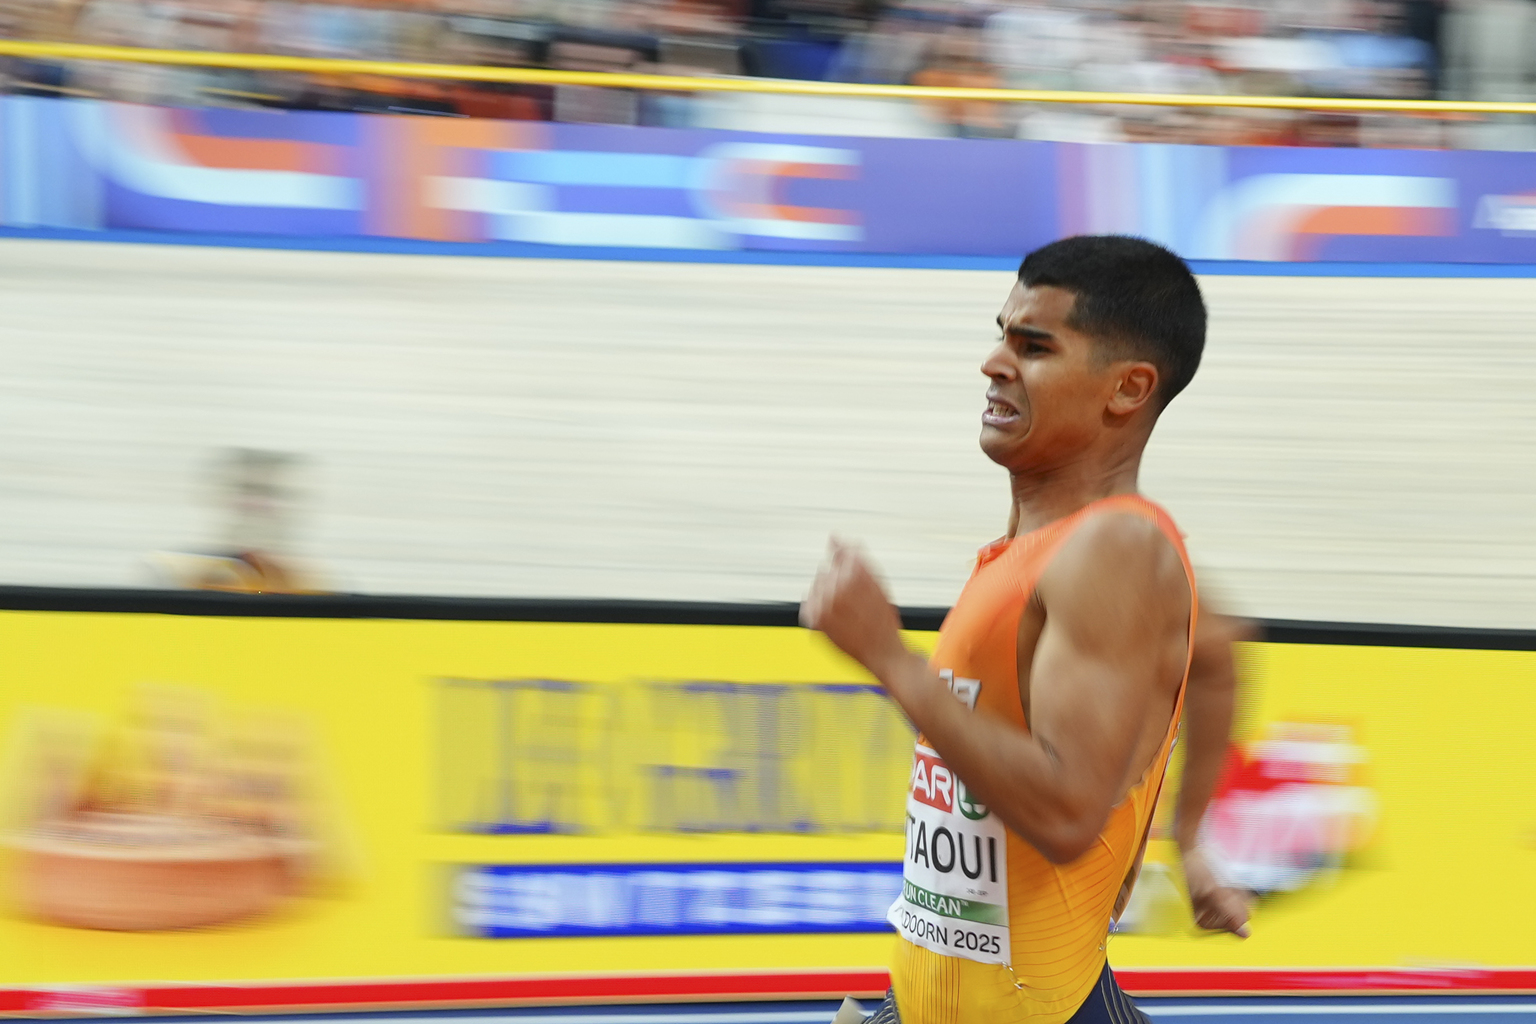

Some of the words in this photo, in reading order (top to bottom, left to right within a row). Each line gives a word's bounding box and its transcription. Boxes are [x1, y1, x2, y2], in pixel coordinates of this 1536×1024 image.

[912, 759, 952, 807] AR
[906, 813, 998, 883] TAOUI
[901, 909, 948, 946] DOORN
[953, 929, 1000, 955] 2025
